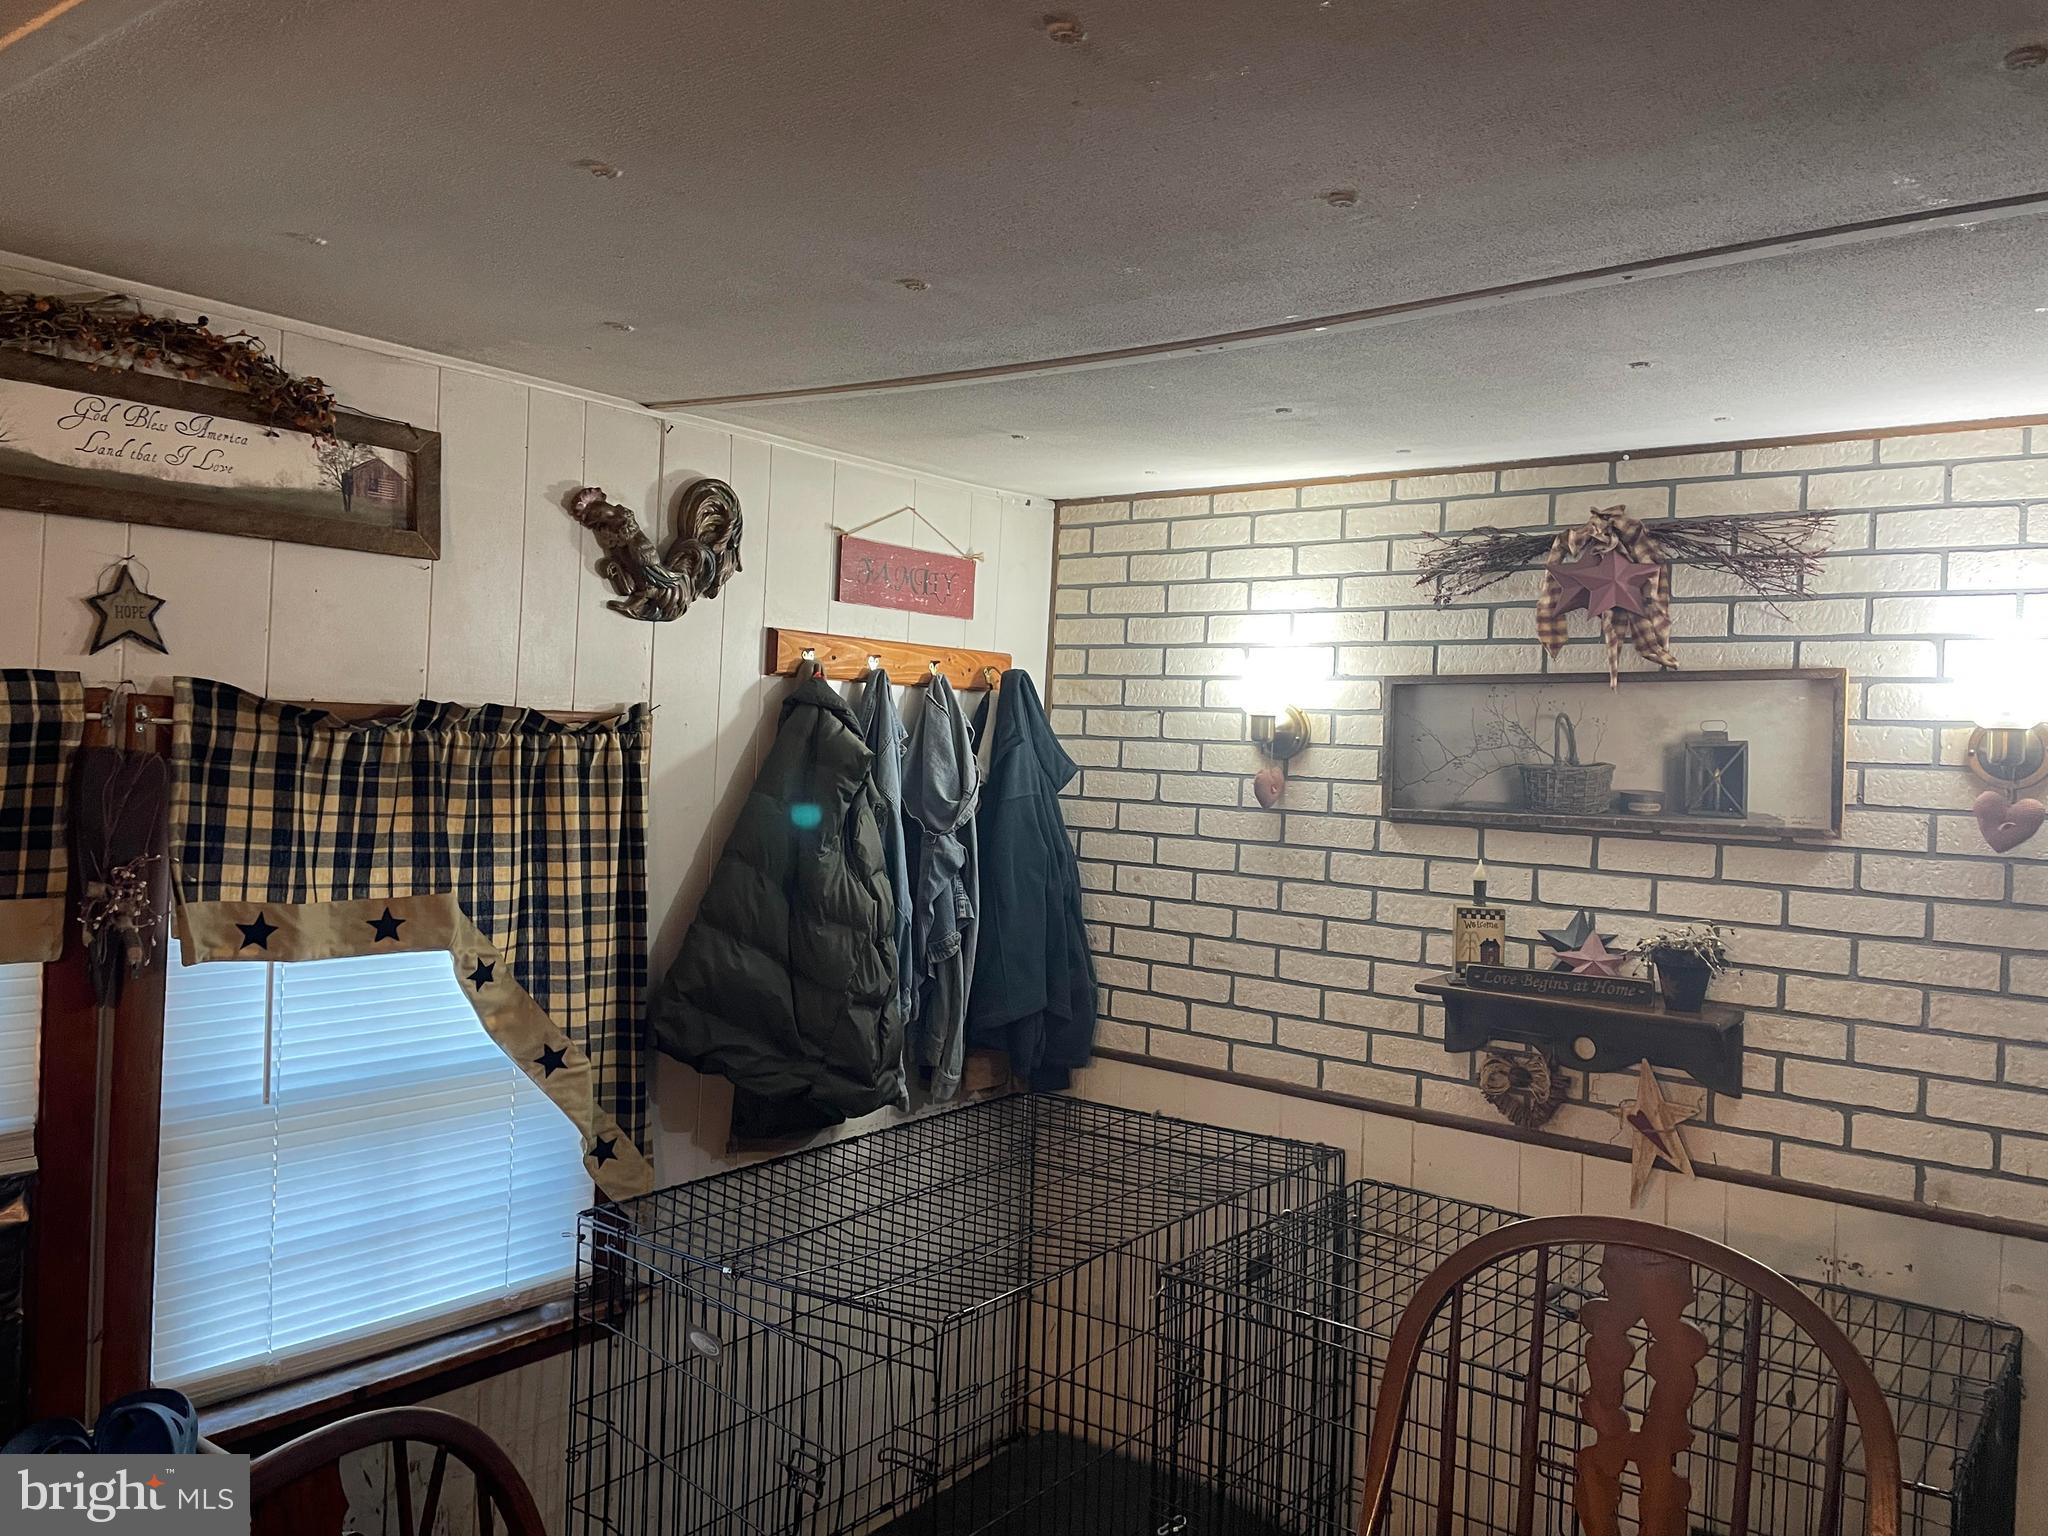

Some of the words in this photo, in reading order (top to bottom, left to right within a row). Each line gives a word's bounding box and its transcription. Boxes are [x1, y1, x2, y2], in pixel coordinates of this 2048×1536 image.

[57, 396, 121, 430] God
[123, 405, 168, 432] Bless
[174, 415, 249, 446] America
[75, 430, 135, 459] Land
[130, 442, 158, 463] that
[164, 445, 197, 466] I
[193, 449, 234, 474] Love
[114, 605, 147, 619] HOPE
[1463, 919, 1500, 929] Welcome
[1482, 970, 1517, 985] Love
[1521, 973, 1569, 992] Begins
[1573, 980, 1588, 992] at
[1591, 981, 1636, 997] Home
